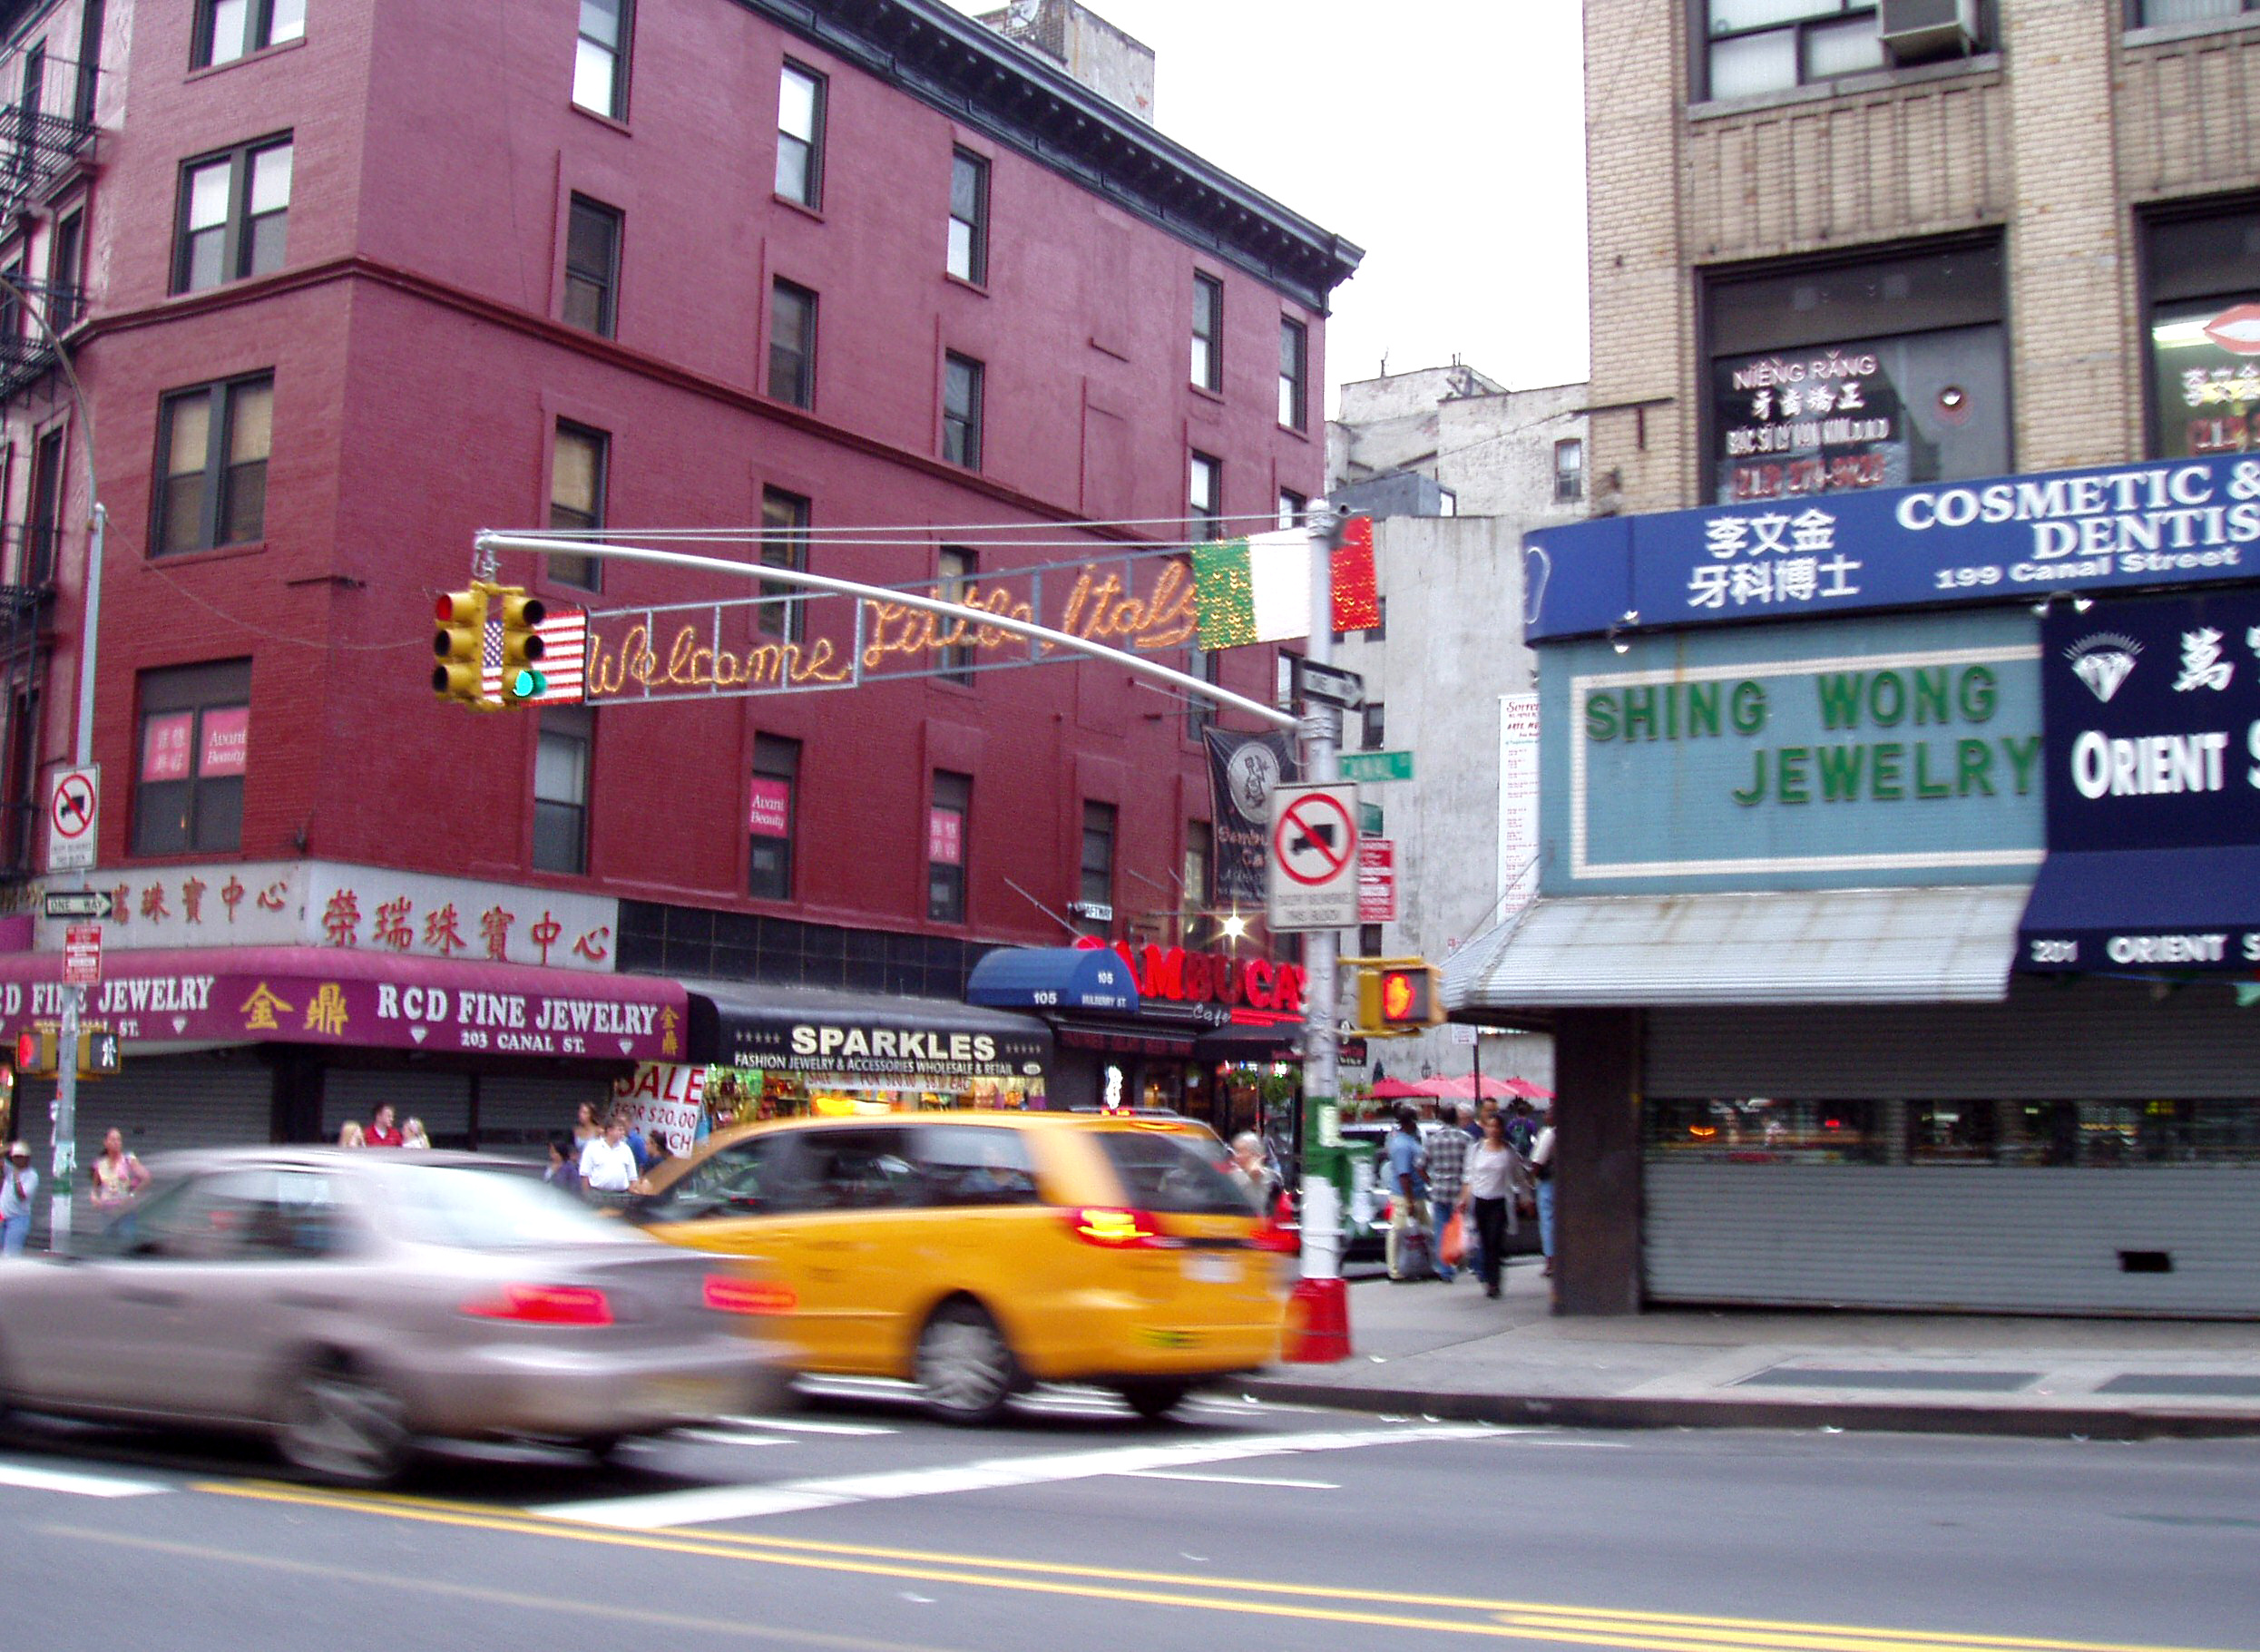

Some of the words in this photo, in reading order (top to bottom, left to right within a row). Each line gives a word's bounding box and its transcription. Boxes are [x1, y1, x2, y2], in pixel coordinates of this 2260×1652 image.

[1895, 465, 2214, 530] COSMETIC
[2226, 459, 2260, 501] &
[1706, 508, 1835, 560] 李文金
[1689, 554, 1861, 609] 牙科博士
[1935, 565, 2001, 590] 199
[2010, 555, 2112, 582] Canal
[2119, 544, 2242, 573] Street
[589, 624, 854, 693] Welcome
[1585, 680, 1768, 742] SHING
[1815, 665, 1998, 730] WONG
[1731, 737, 2041, 806] JEWELRY
[750, 810, 784, 829] Beauty
[51, 899, 72, 911] ONE
[83, 899, 103, 911] WAY
[2107, 934, 2229, 963] ORIENT
[98, 976, 213, 1013] JEWELRY
[1098, 971, 1114, 985] 105
[240, 982, 349, 1035] 金鼎
[377, 983, 449, 1022] RCD
[458, 991, 526, 1030] FINE
[536, 999, 658, 1035] JEWELRY
[1032, 992, 1058, 1006] 105
[119, 1018, 140, 1036] ST.
[461, 1031, 488, 1049] 203
[498, 1032, 555, 1052] CANAL
[563, 1037, 585, 1054] ST.
[791, 1025, 996, 1062] SPARKLES
[735, 1052, 786, 1069] FASHION
[788, 1054, 835, 1070] JEWELRY
[836, 1057, 845, 1070] &
[847, 1057, 915, 1074] ACCESSORIES
[916, 1060, 973, 1075] WHOLESALE
[975, 1062, 982, 1075] &
[984, 1062, 1013, 1076] RETAIL
[617, 1064, 706, 1106] SALE
[648, 1107, 697, 1129] $20.00
